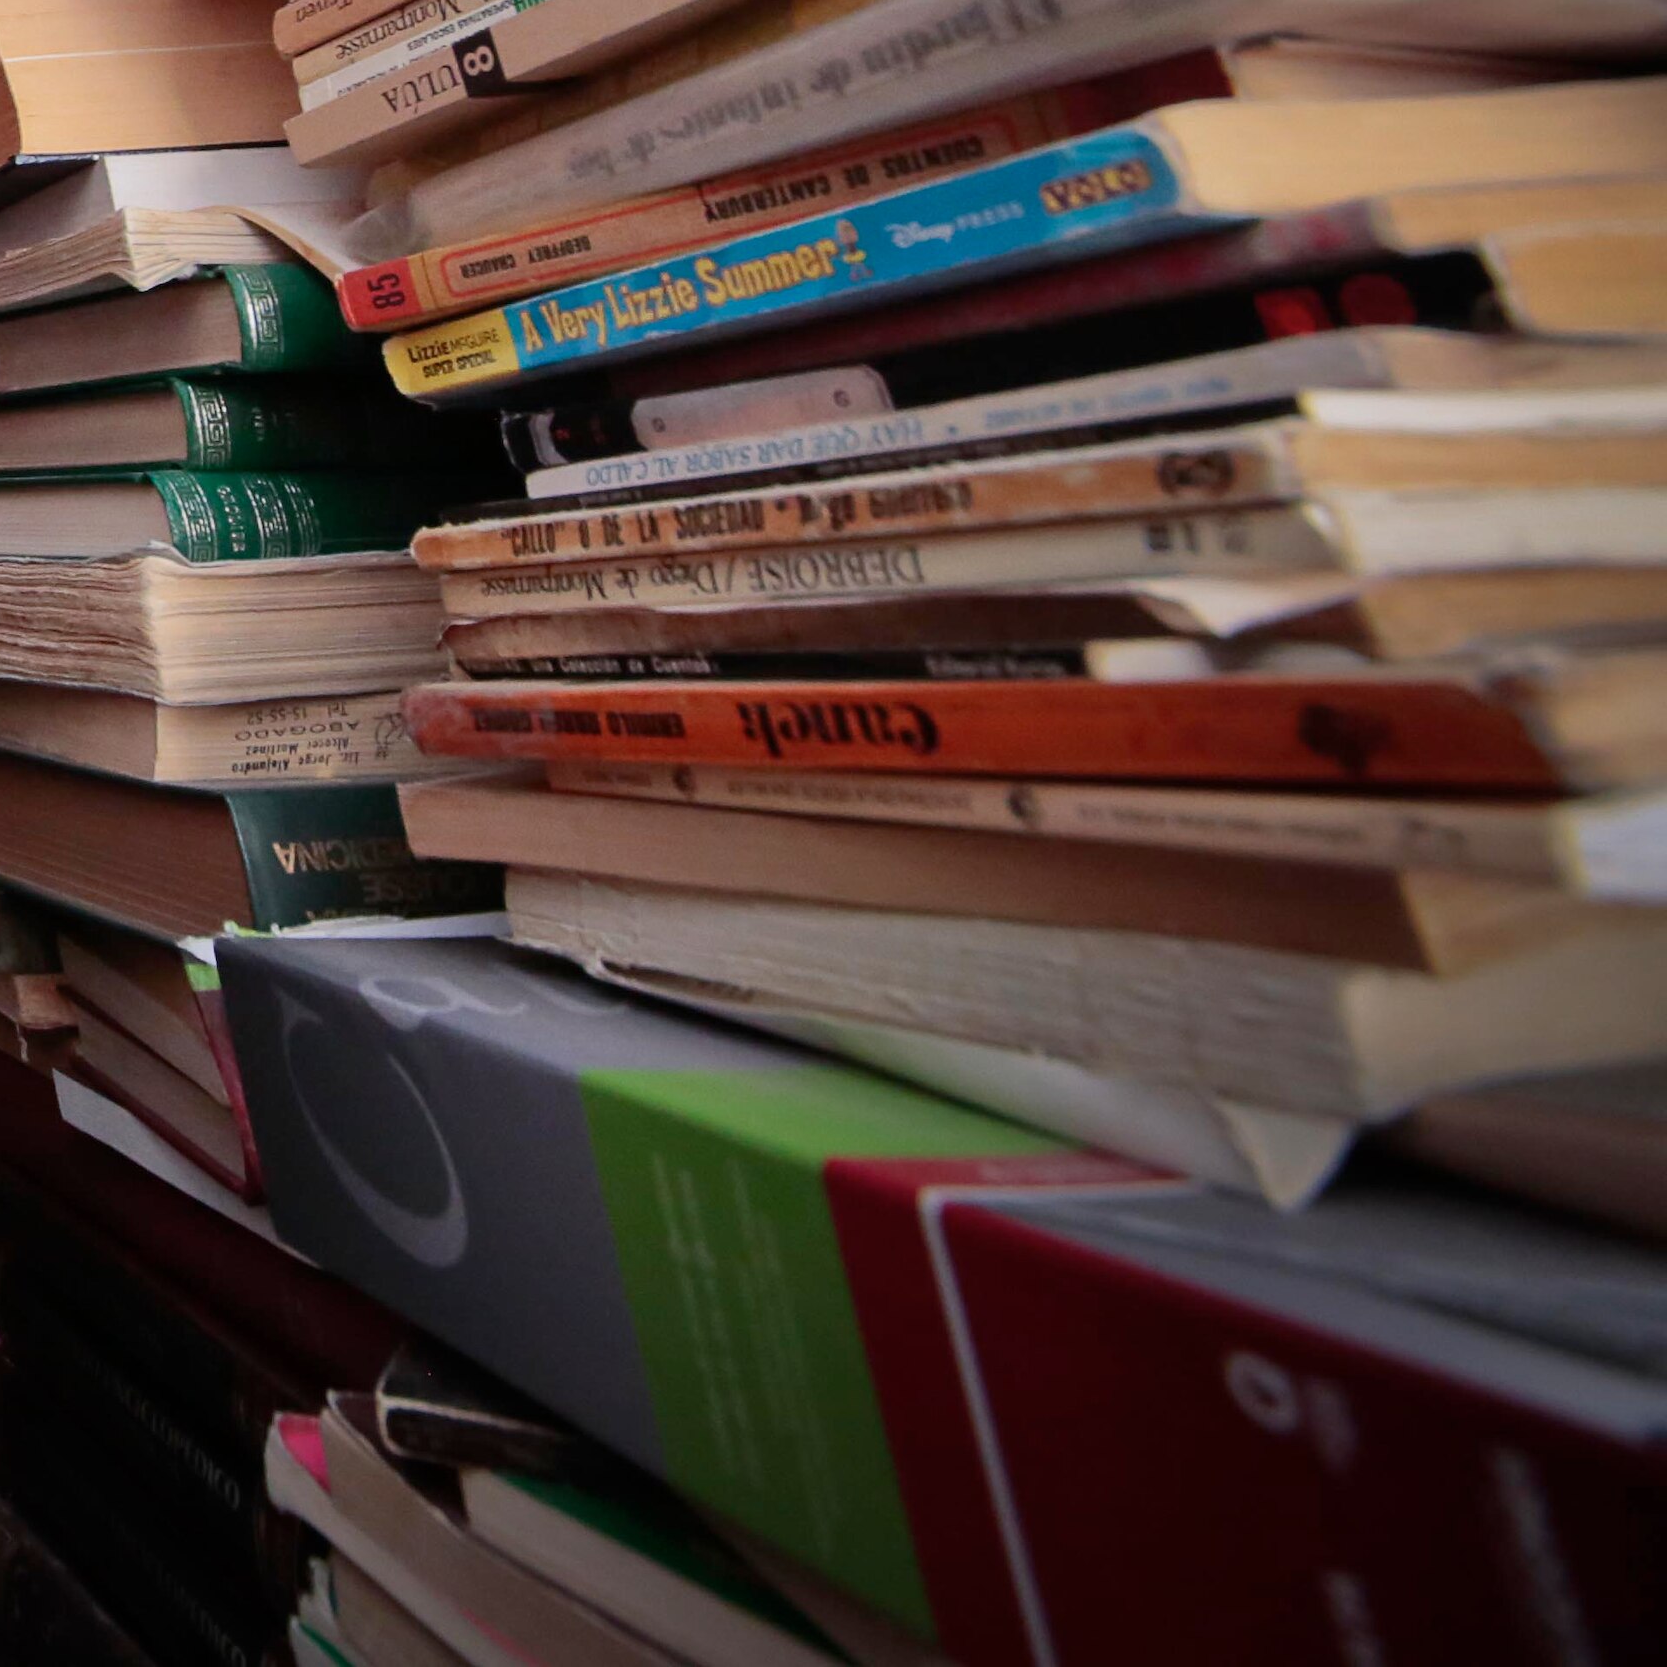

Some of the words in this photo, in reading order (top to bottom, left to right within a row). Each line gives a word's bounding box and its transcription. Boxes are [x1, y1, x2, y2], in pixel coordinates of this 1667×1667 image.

[381, 63, 467, 117] ULÚA
[884, 133, 984, 178] CUENTOS
[838, 162, 870, 189] DE
[699, 171, 831, 222] CANTERBURY
[955, 202, 1024, 231] PRESS
[367, 273, 407, 310] 85
[517, 308, 545, 353] A
[539, 288, 615, 359] Very
[604, 269, 702, 331] Lizzie
[407, 339, 450, 363] Lizzie
[420, 356, 455, 382] SUPER
[455, 348, 495, 370] SPECIAL
[806, 427, 861, 459] QUE
[870, 419, 924, 449] HAY
[684, 443, 754, 475] SABOR
[755, 435, 807, 466] DAR
[585, 458, 649, 487] CALDO
[652, 456, 679, 478] AL
[673, 497, 766, 541] SOCIEDAD
[614, 569, 640, 602] de
[648, 562, 720, 599] Diego
[744, 548, 924, 593] DEBROISE
[234, 721, 361, 742] ABOGADO
[246, 706, 309, 726] 15-55-52
[737, 703, 940, 746] Canek
[231, 758, 291, 776] Alejandro
[298, 753, 332, 767] Jorge
